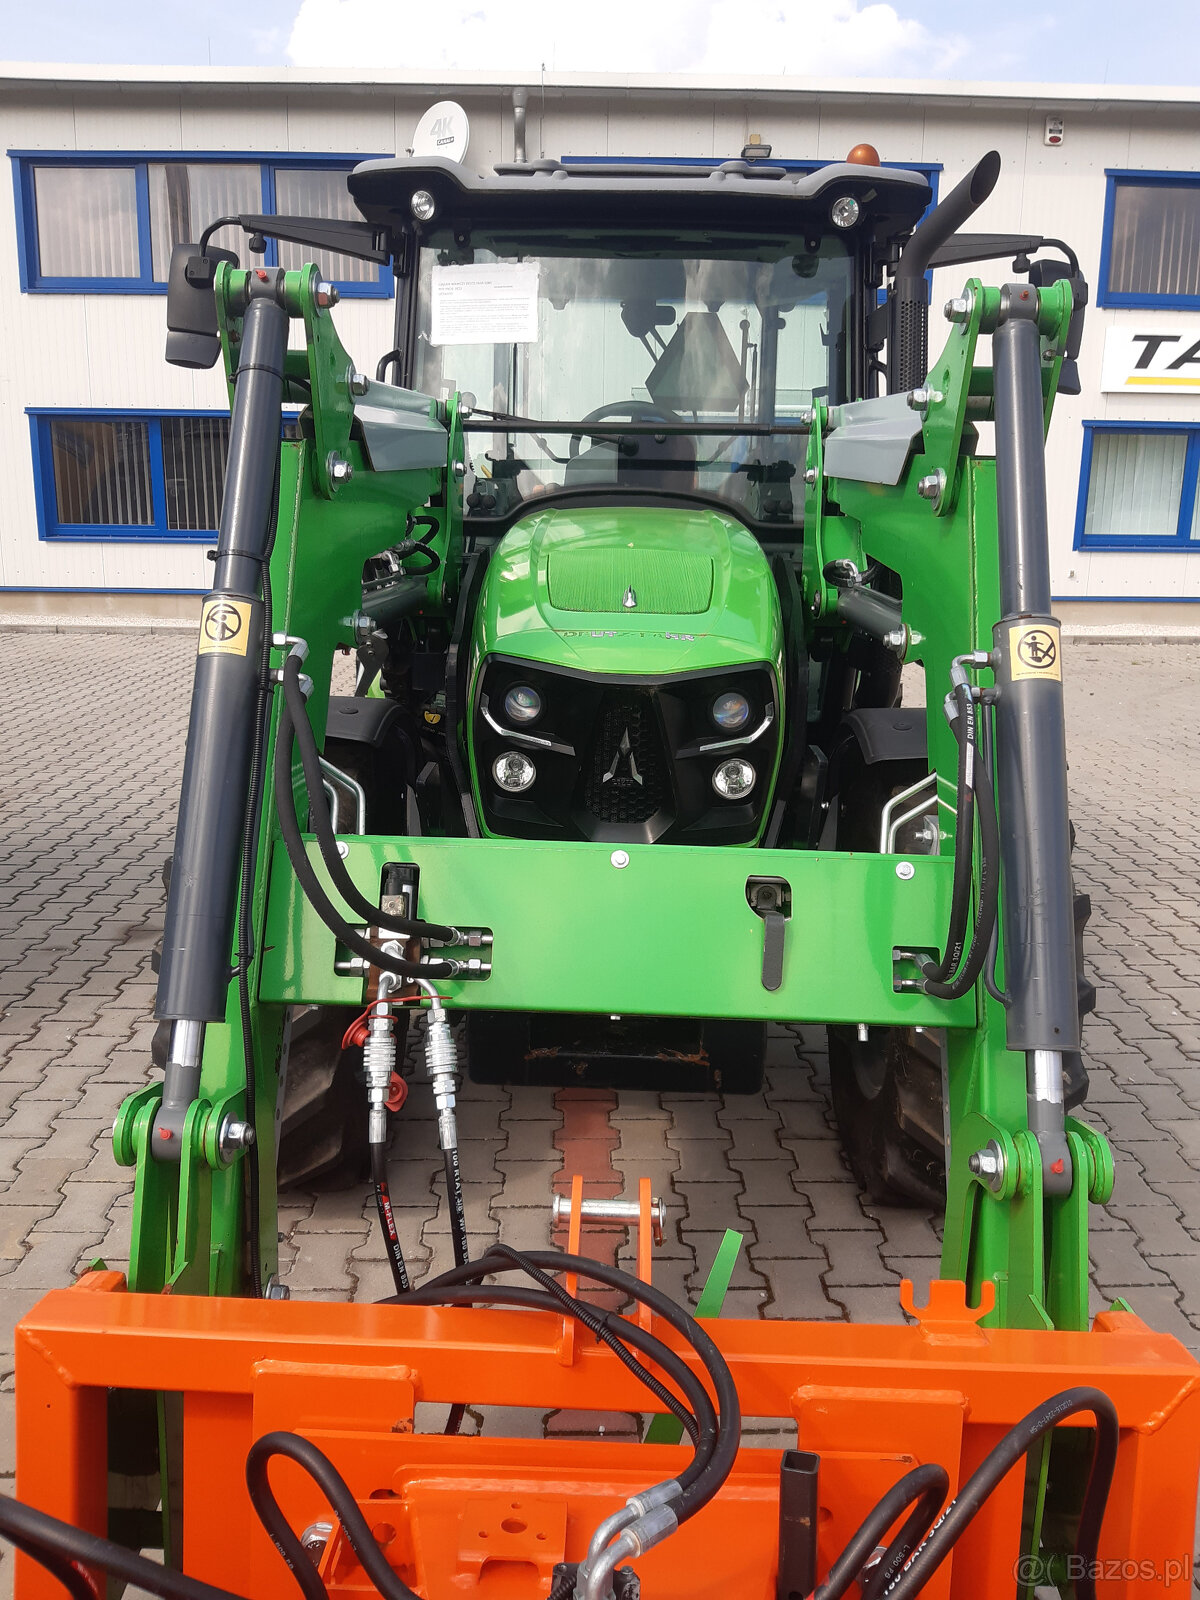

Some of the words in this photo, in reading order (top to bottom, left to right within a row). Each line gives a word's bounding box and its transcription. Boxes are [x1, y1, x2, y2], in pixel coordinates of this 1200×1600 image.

[430, 115, 454, 138] 4K
[966, 703, 974, 715] 853
[966, 715, 974, 726] EN
[966, 727, 974, 740] DIN
[384, 1201, 396, 1236] M-FLEX
[393, 1243, 402, 1260] DIN
[396, 1261, 405, 1273] EN
[893, 1544, 911, 1566] L-500
